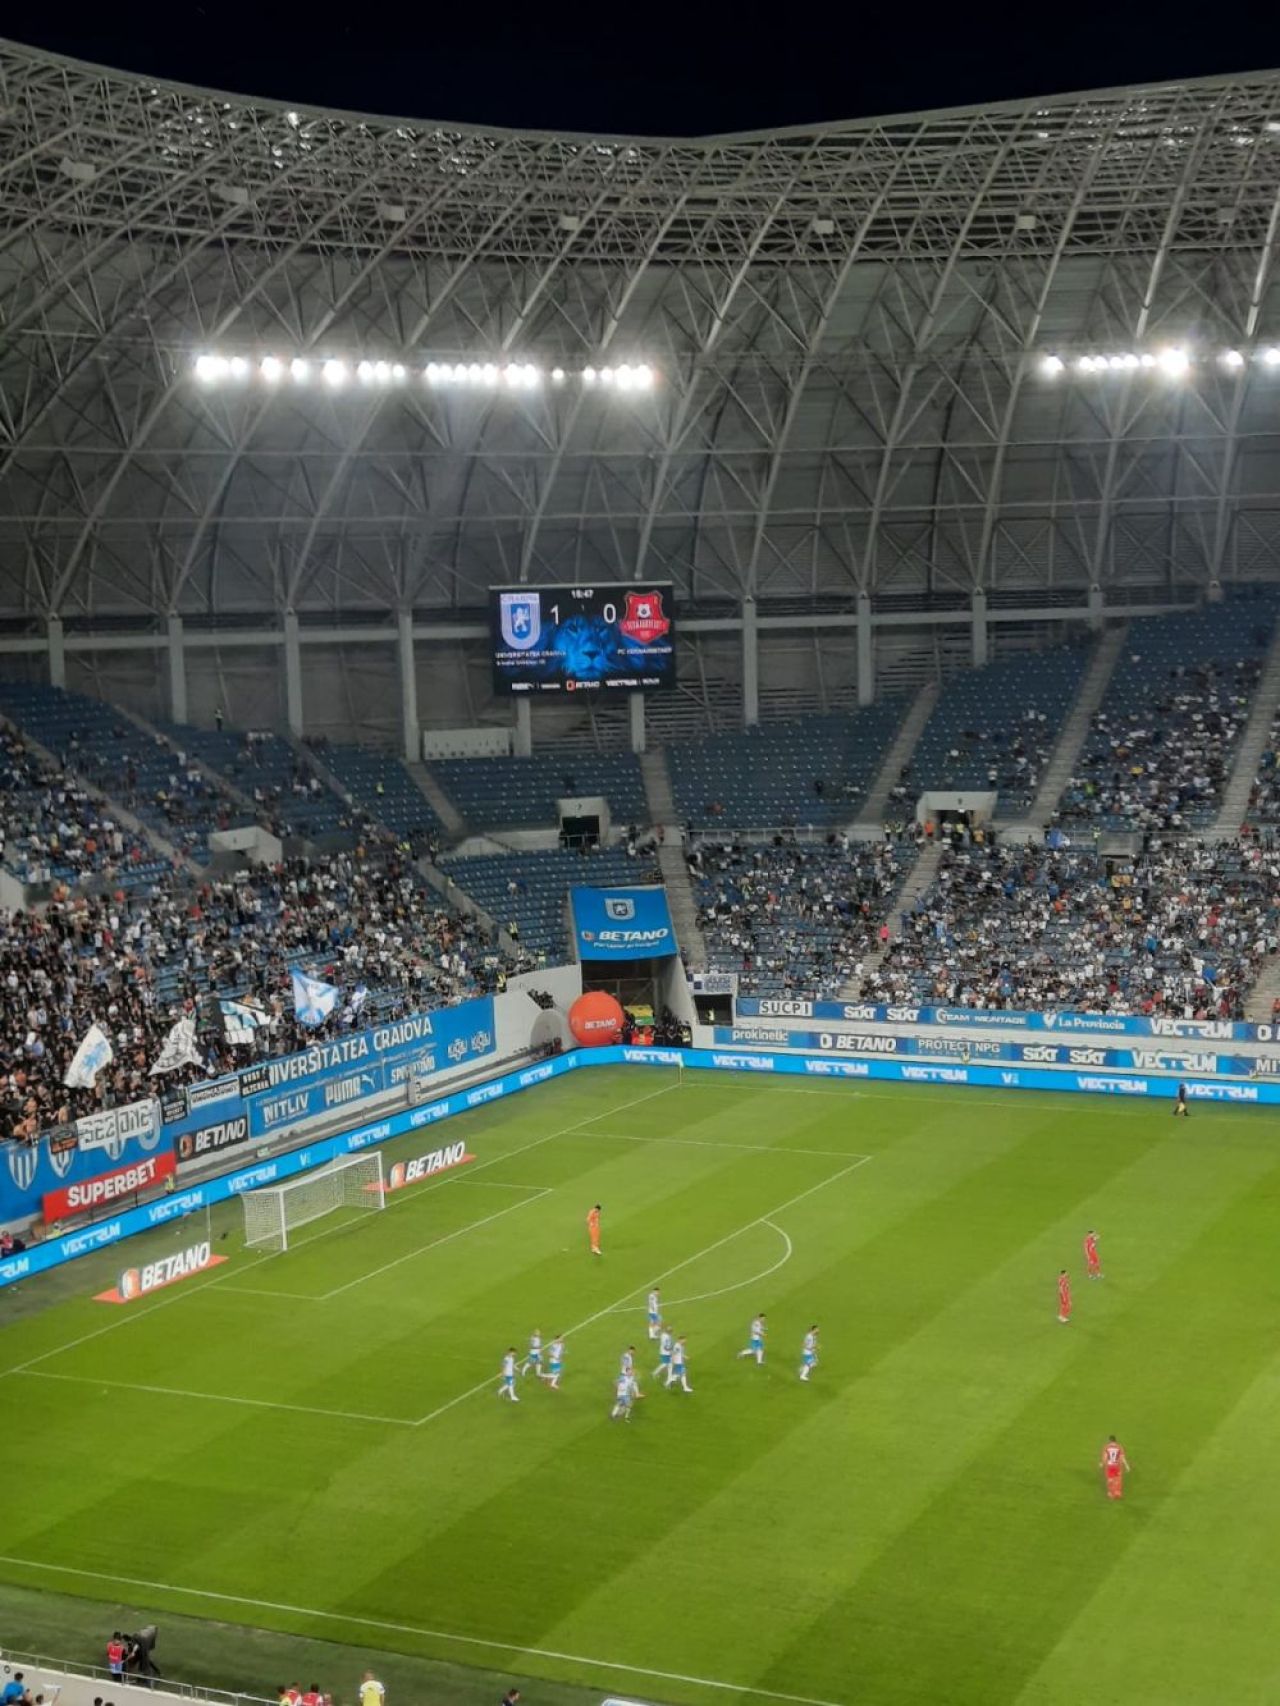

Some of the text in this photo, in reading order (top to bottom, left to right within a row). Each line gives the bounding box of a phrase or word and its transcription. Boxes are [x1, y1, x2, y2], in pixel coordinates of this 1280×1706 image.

[551, 604, 559, 625] 1
[603, 603, 617, 624] 0
[599, 928, 669, 942] BETANO
[373, 1016, 433, 1051] CRAIOVA
[584, 1018, 617, 1030] BETANO
[1059, 1016, 1126, 1031] La Provincia
[1150, 1018, 1233, 1039] VECTRUM
[732, 1027, 788, 1042] prokinetic
[836, 1035, 897, 1052] BETANO
[918, 1039, 1001, 1053] PROTECT NPG
[1133, 1051, 1217, 1073] VECTRUM
[325, 1076, 361, 1107] PUMA
[195, 1118, 246, 1152] BETANO
[405, 1141, 466, 1182] BETANO
[67, 1158, 156, 1207] SUPERBET
[140, 1242, 211, 1291] BETANO
